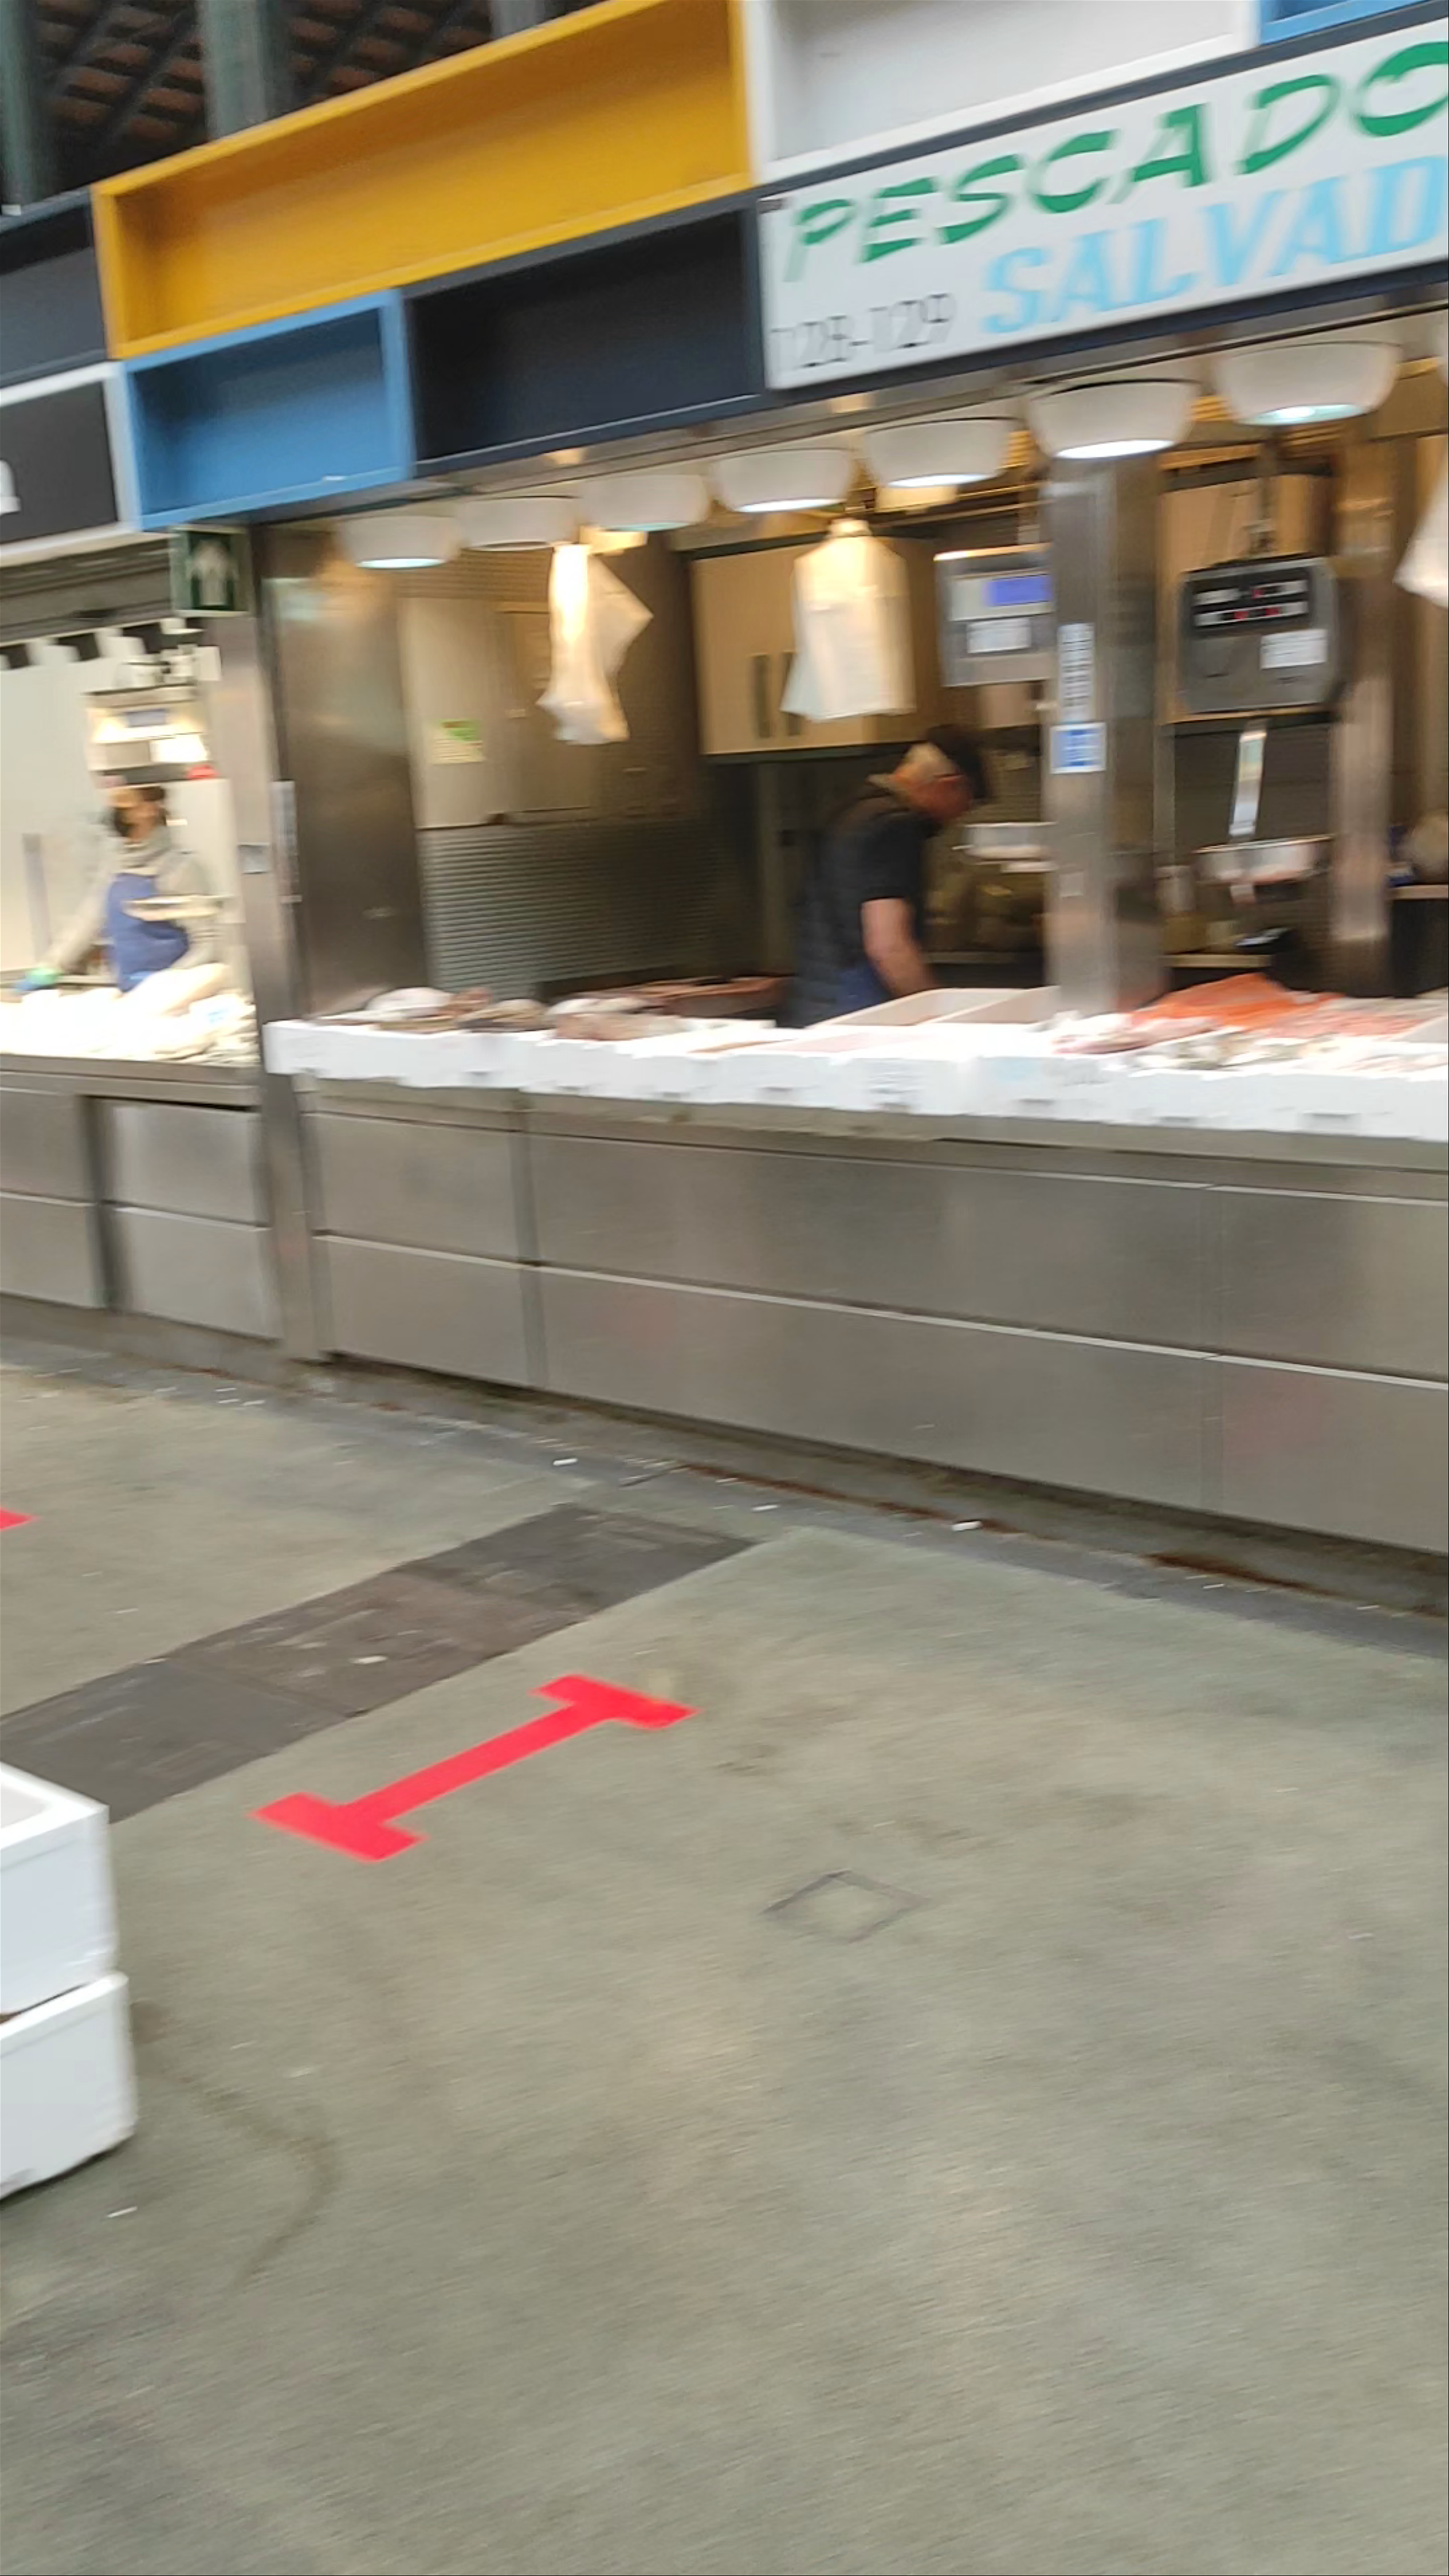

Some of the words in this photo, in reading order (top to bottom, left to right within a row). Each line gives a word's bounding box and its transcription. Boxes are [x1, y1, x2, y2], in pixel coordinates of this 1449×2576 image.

[783, 41, 1449, 282] PESCADO
[981, 155, 1449, 335] SALVAD
[771, 292, 958, 372] 128-129
